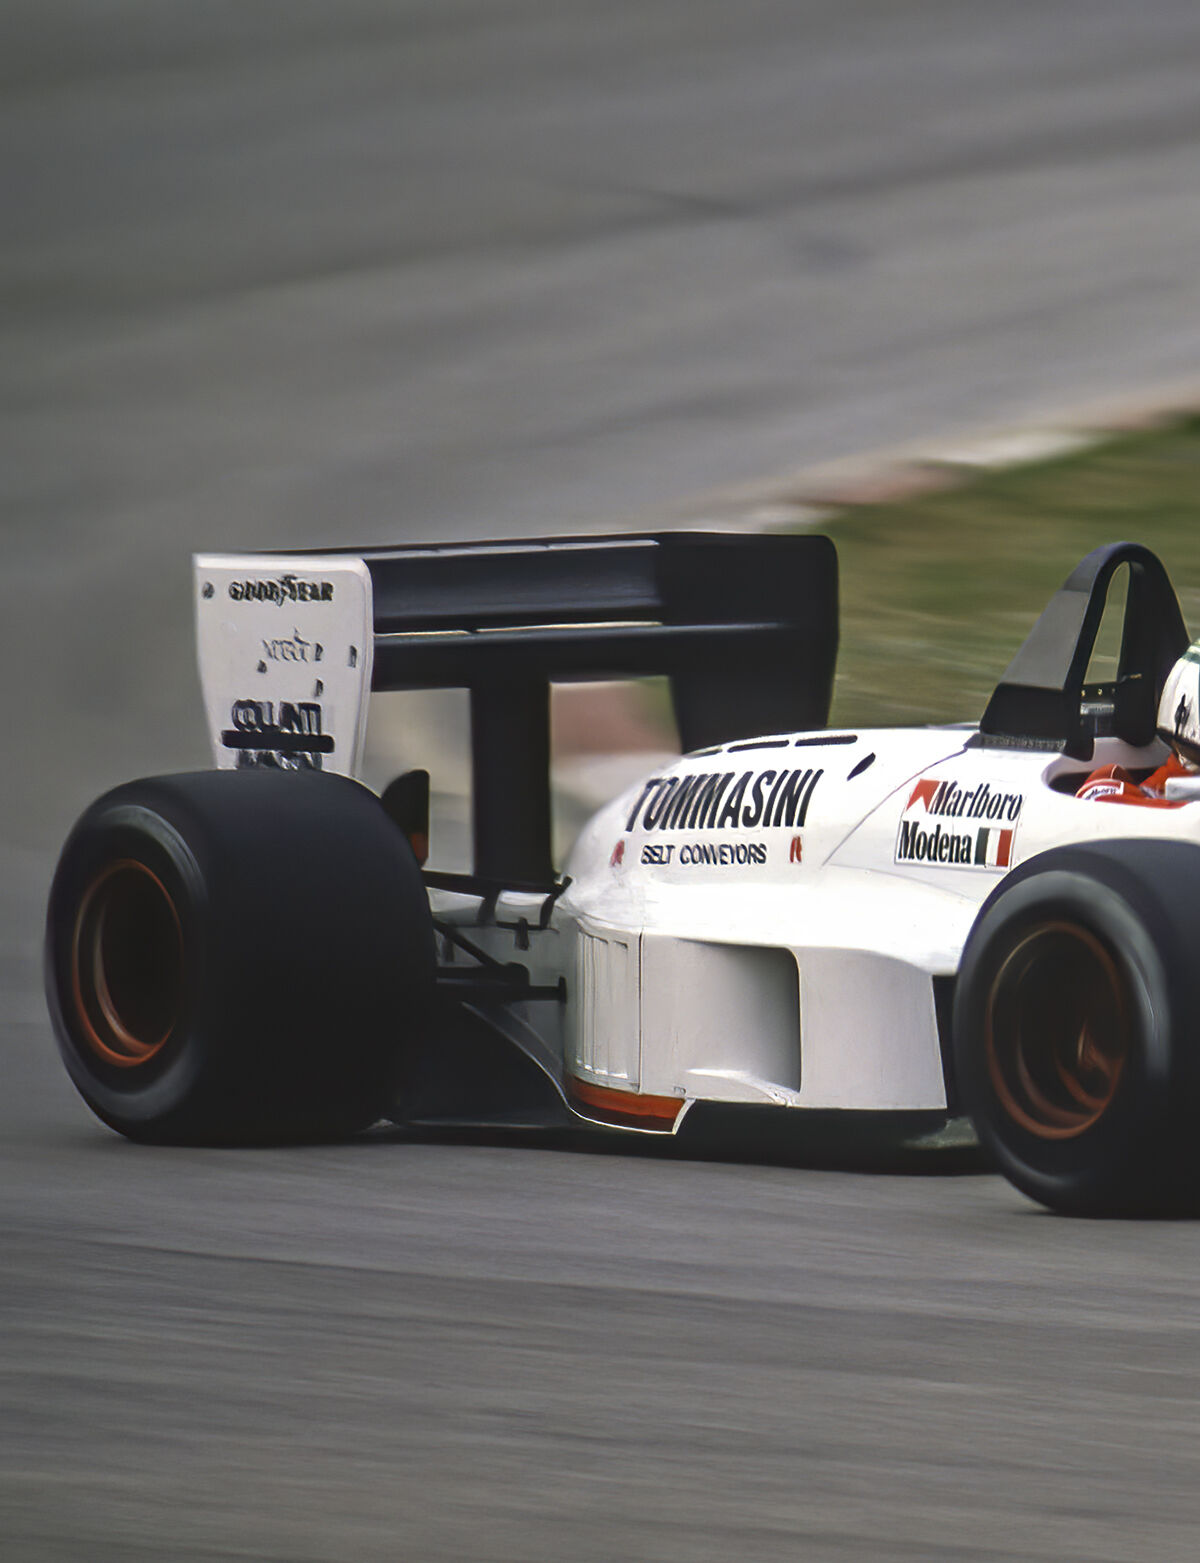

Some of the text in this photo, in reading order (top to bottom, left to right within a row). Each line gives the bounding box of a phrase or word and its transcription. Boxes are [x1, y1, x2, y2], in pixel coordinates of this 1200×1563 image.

[625, 769, 824, 832] TOMMASINI
[929, 780, 1023, 821] Marlboro
[898, 820, 972, 864] Modena
